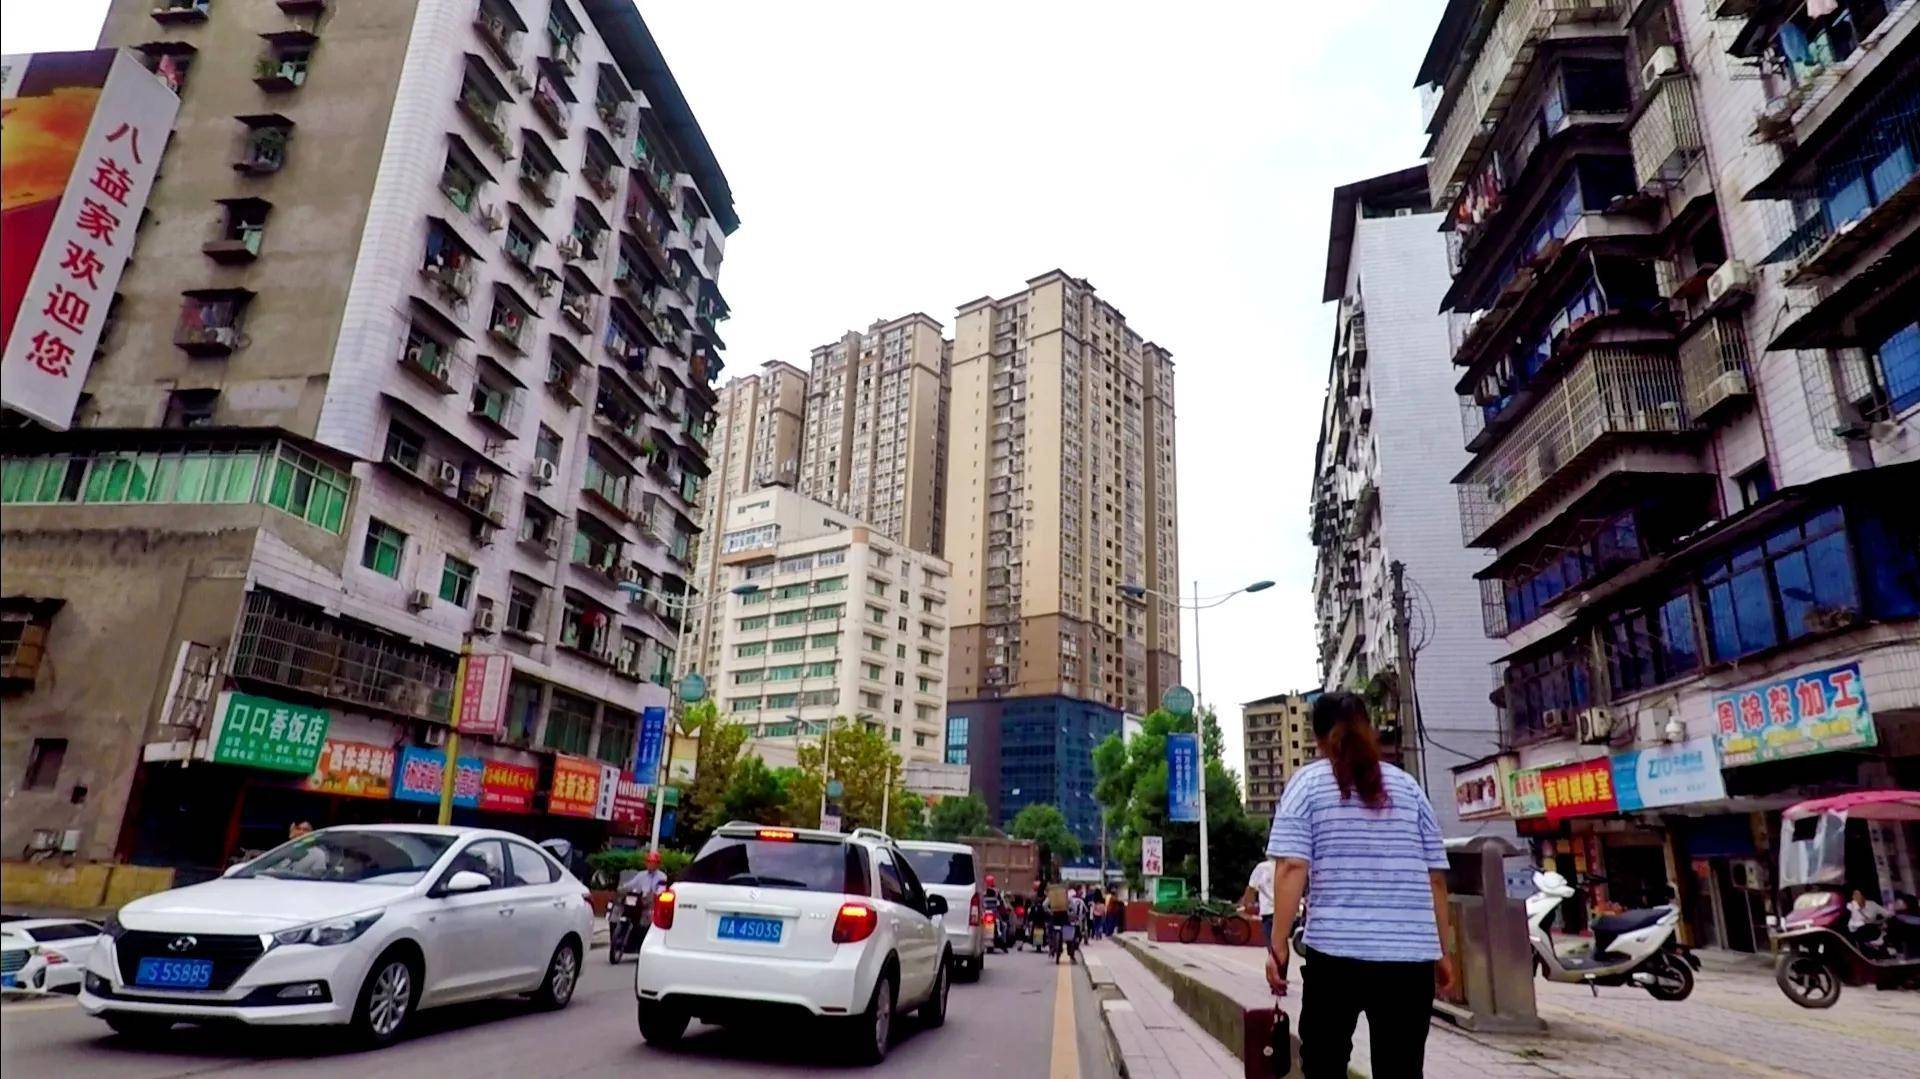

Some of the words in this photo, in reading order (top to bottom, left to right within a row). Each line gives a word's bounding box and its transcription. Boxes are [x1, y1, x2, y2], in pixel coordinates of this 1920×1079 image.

[26, 122, 142, 378] 八益家欢迎您
[228, 704, 324, 746] 口口香饭店
